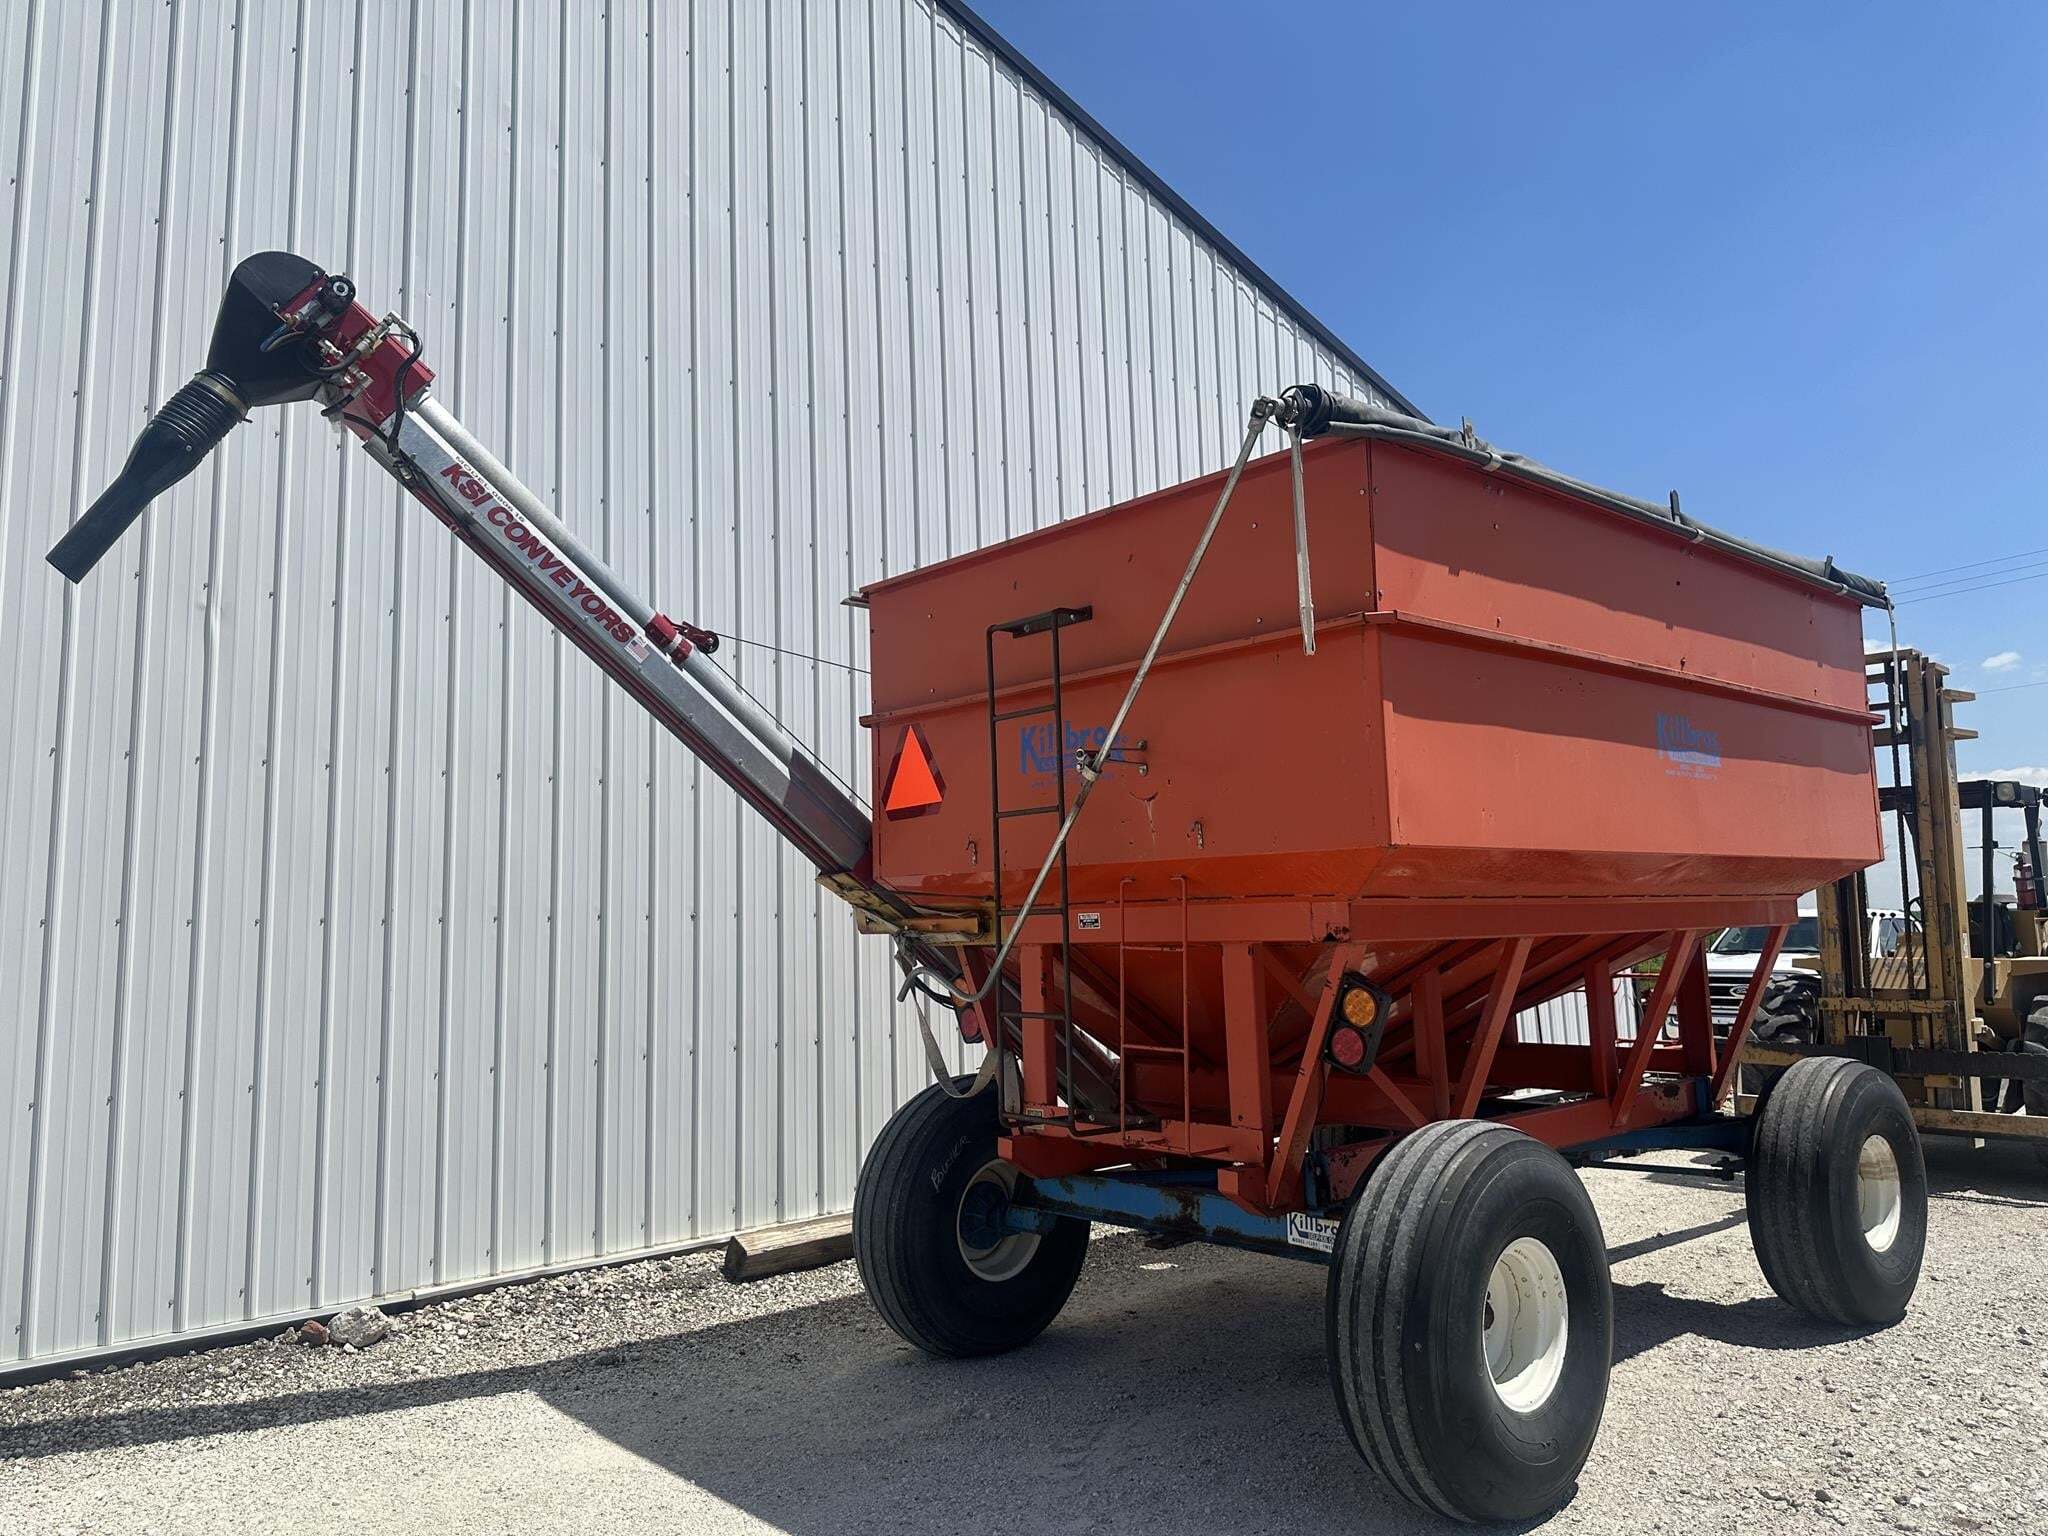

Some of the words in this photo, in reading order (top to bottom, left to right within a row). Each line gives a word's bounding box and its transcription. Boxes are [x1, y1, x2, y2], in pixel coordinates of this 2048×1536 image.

[455, 456, 491, 491] MODEL
[440, 463, 494, 507] KSI
[487, 506, 636, 643] CONVEYORS
[1019, 720, 1131, 776] Kilbro
[1290, 1213, 1340, 1236] Killbro
